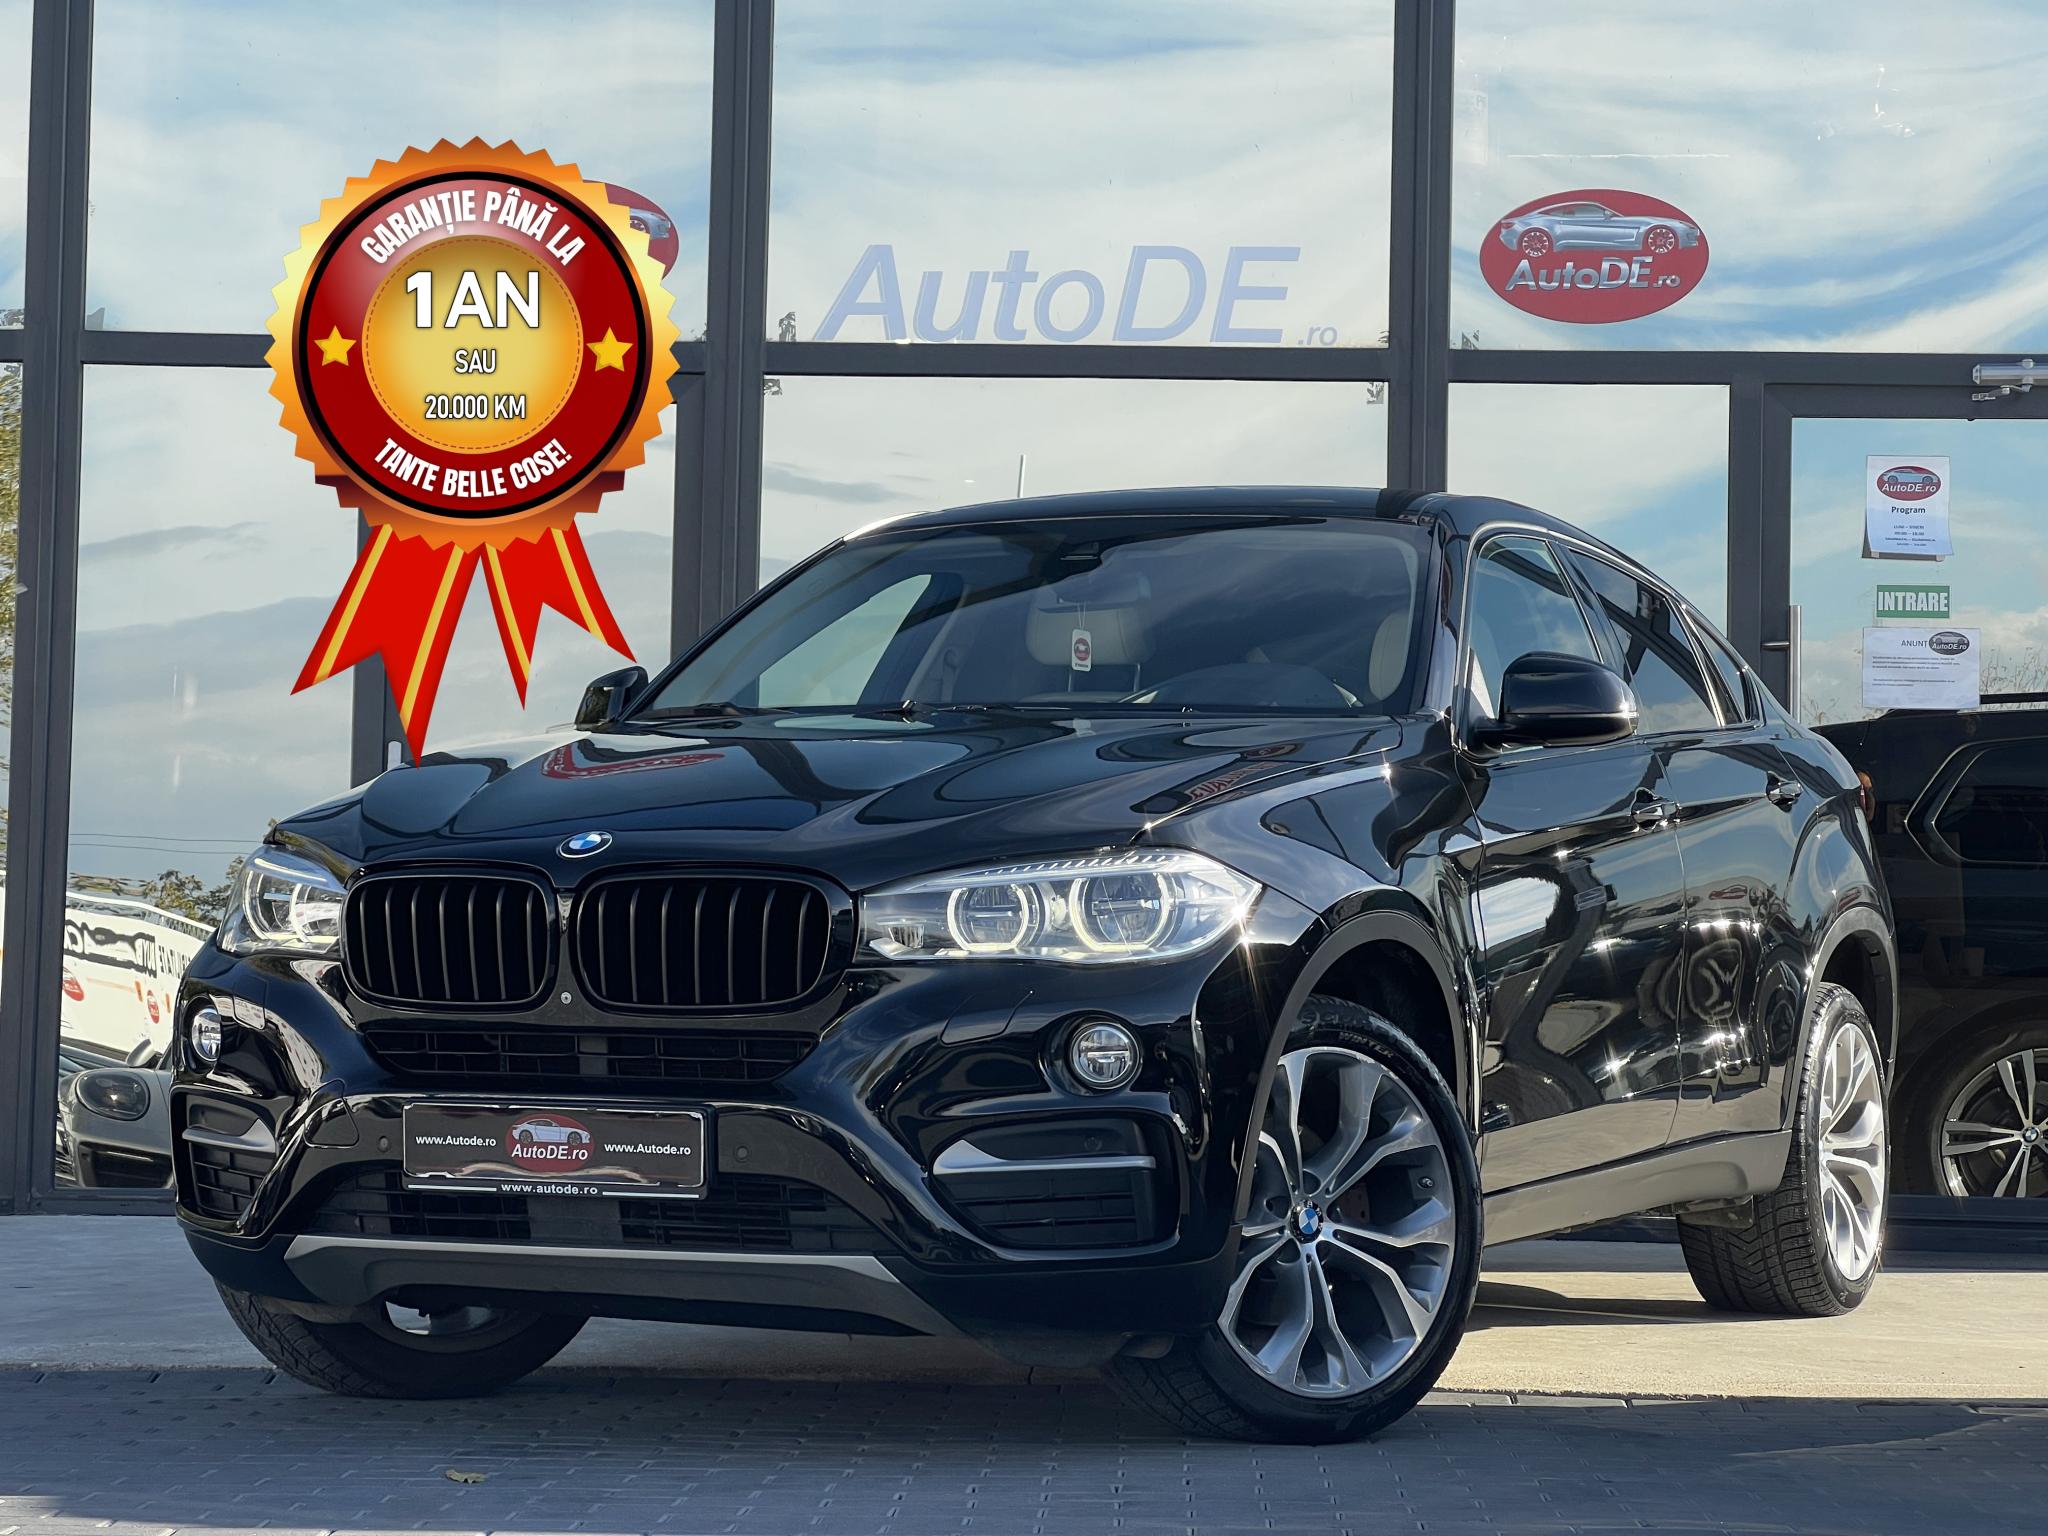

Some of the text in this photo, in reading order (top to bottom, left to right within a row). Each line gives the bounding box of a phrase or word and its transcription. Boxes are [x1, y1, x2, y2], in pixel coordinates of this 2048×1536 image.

[1881, 483, 1937, 492] AutoDE.ro
[1891, 506, 1926, 515] Program
[1878, 591, 1949, 612] INTRARE
[415, 1134, 497, 1147] www.Autode.ro
[511, 1143, 589, 1161] AutoDE.ro
[604, 1142, 692, 1155] www.Autode.ro
[501, 1183, 598, 1195] www.autode.ro
